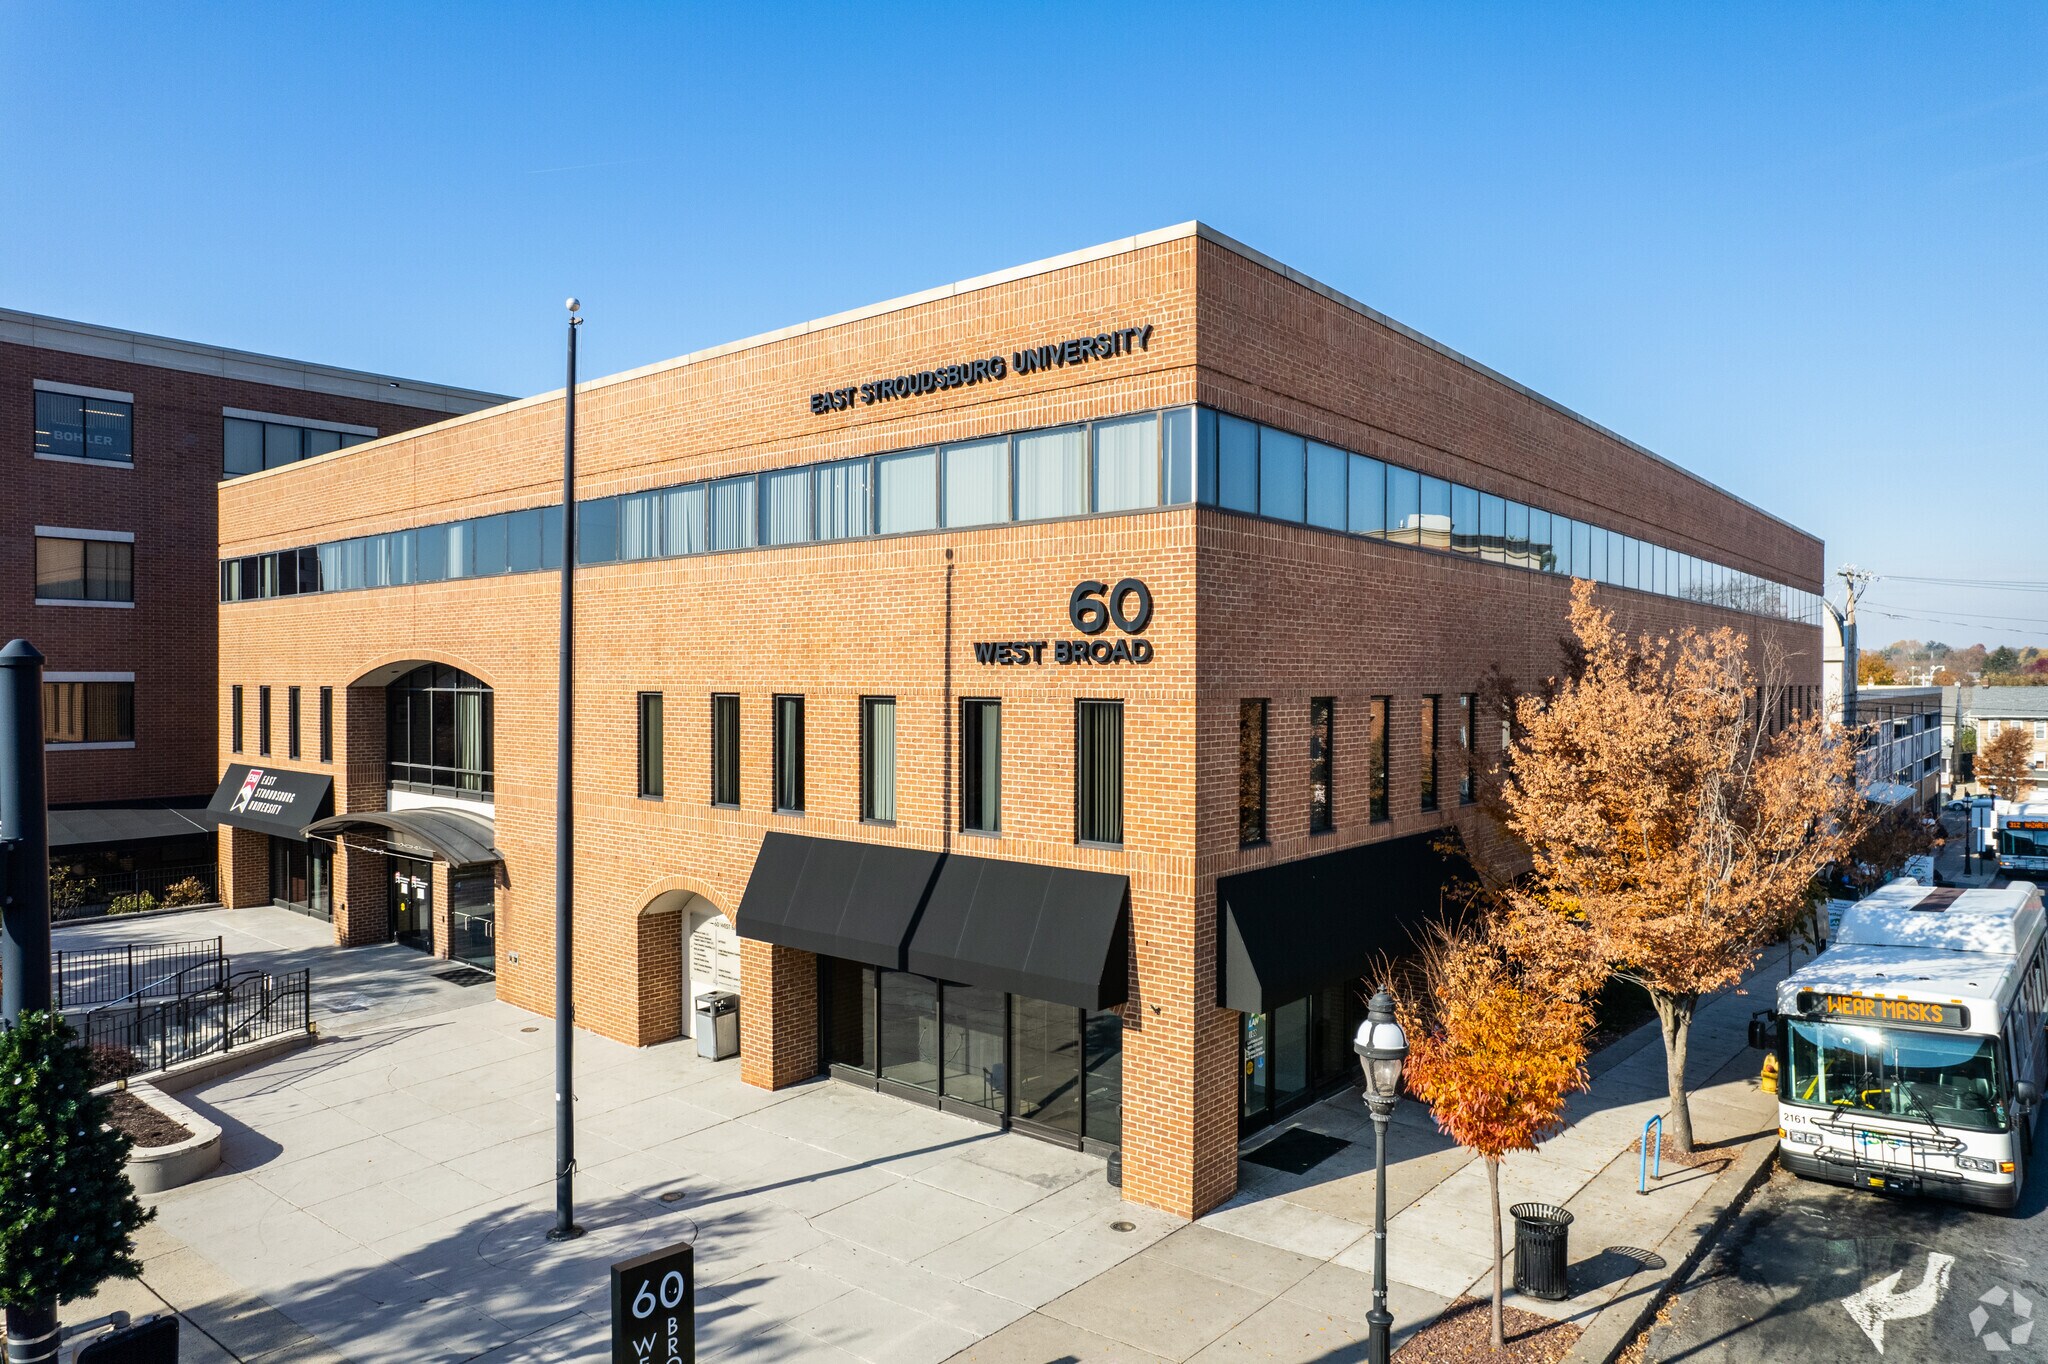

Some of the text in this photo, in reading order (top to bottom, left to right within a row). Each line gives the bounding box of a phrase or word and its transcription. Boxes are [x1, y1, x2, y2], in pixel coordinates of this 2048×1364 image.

[810, 324, 1154, 414] EAST STROUDSBURG UNIVERSITY
[54, 430, 112, 445] BOHLER
[1069, 577, 1154, 635] 60
[974, 639, 1154, 665] WEST BROAD
[247, 774, 261, 783] ESU
[260, 775, 277, 785] EAST
[254, 788, 295, 803] STROUDSBURG
[248, 801, 282, 814] UNIVERSITY
[1827, 995, 1943, 1022] WEAR MASKS
[1784, 1112, 1806, 1125] 2161
[632, 1270, 684, 1318] 60
